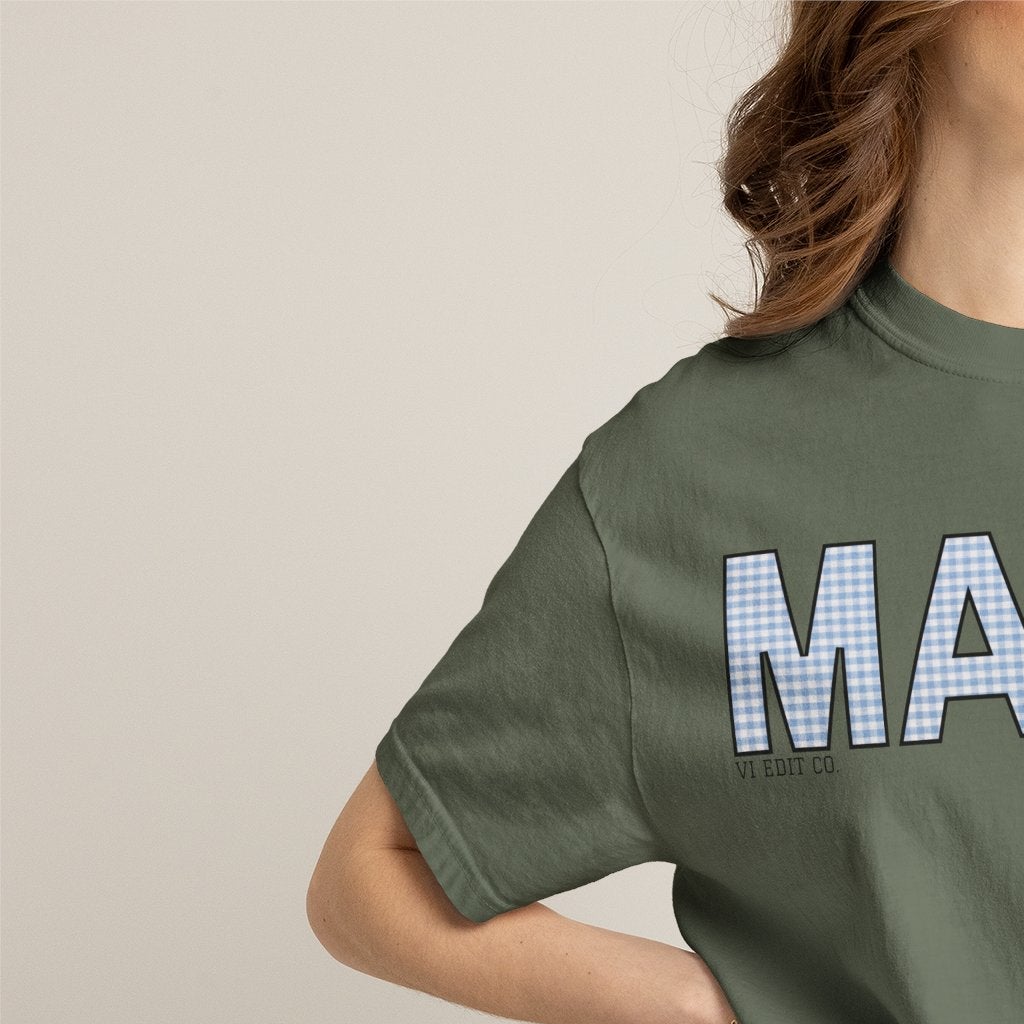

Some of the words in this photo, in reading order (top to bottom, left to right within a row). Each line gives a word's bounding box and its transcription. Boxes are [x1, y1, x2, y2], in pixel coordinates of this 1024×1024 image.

[735, 761, 756, 779] VI
[763, 757, 804, 777] EDIT
[812, 755, 839, 774] CO.
